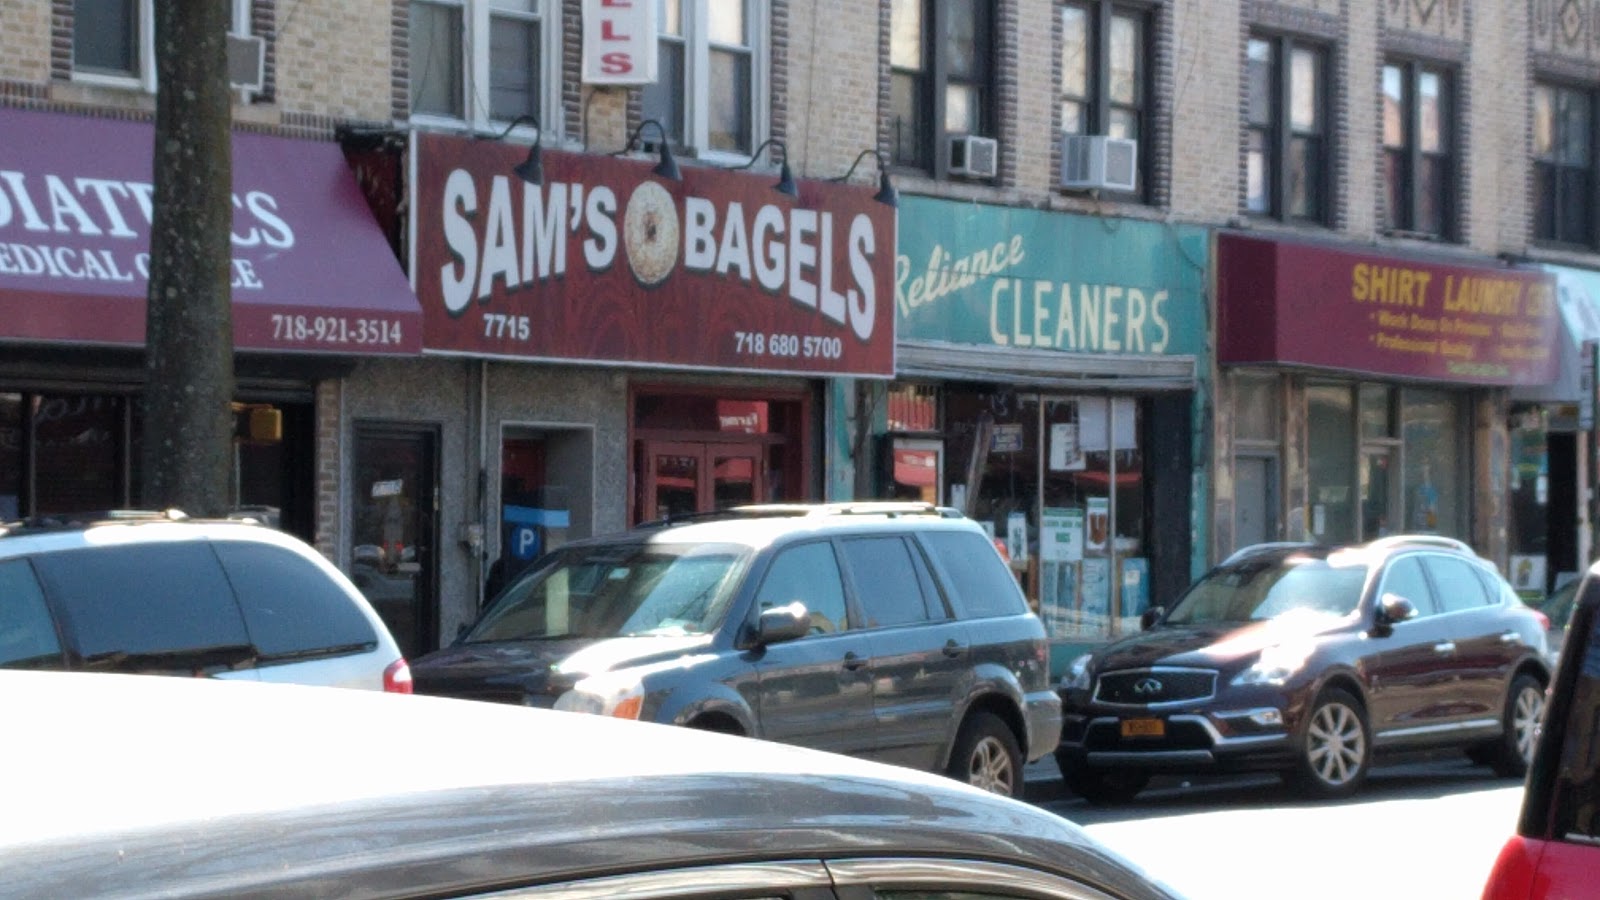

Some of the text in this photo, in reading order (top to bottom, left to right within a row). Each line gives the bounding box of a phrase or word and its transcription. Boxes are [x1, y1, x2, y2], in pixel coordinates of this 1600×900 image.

[440, 168, 876, 341] SAM'S BAGELS
[897, 233, 1025, 318] Reliance
[1352, 262, 1432, 308] SHIRT
[271, 314, 402, 344] 718-921-3514
[482, 312, 530, 341] 7715
[989, 278, 1169, 354] CLEANERS
[734, 331, 842, 359] 718 680 5700
[518, 529, 535, 554] P
